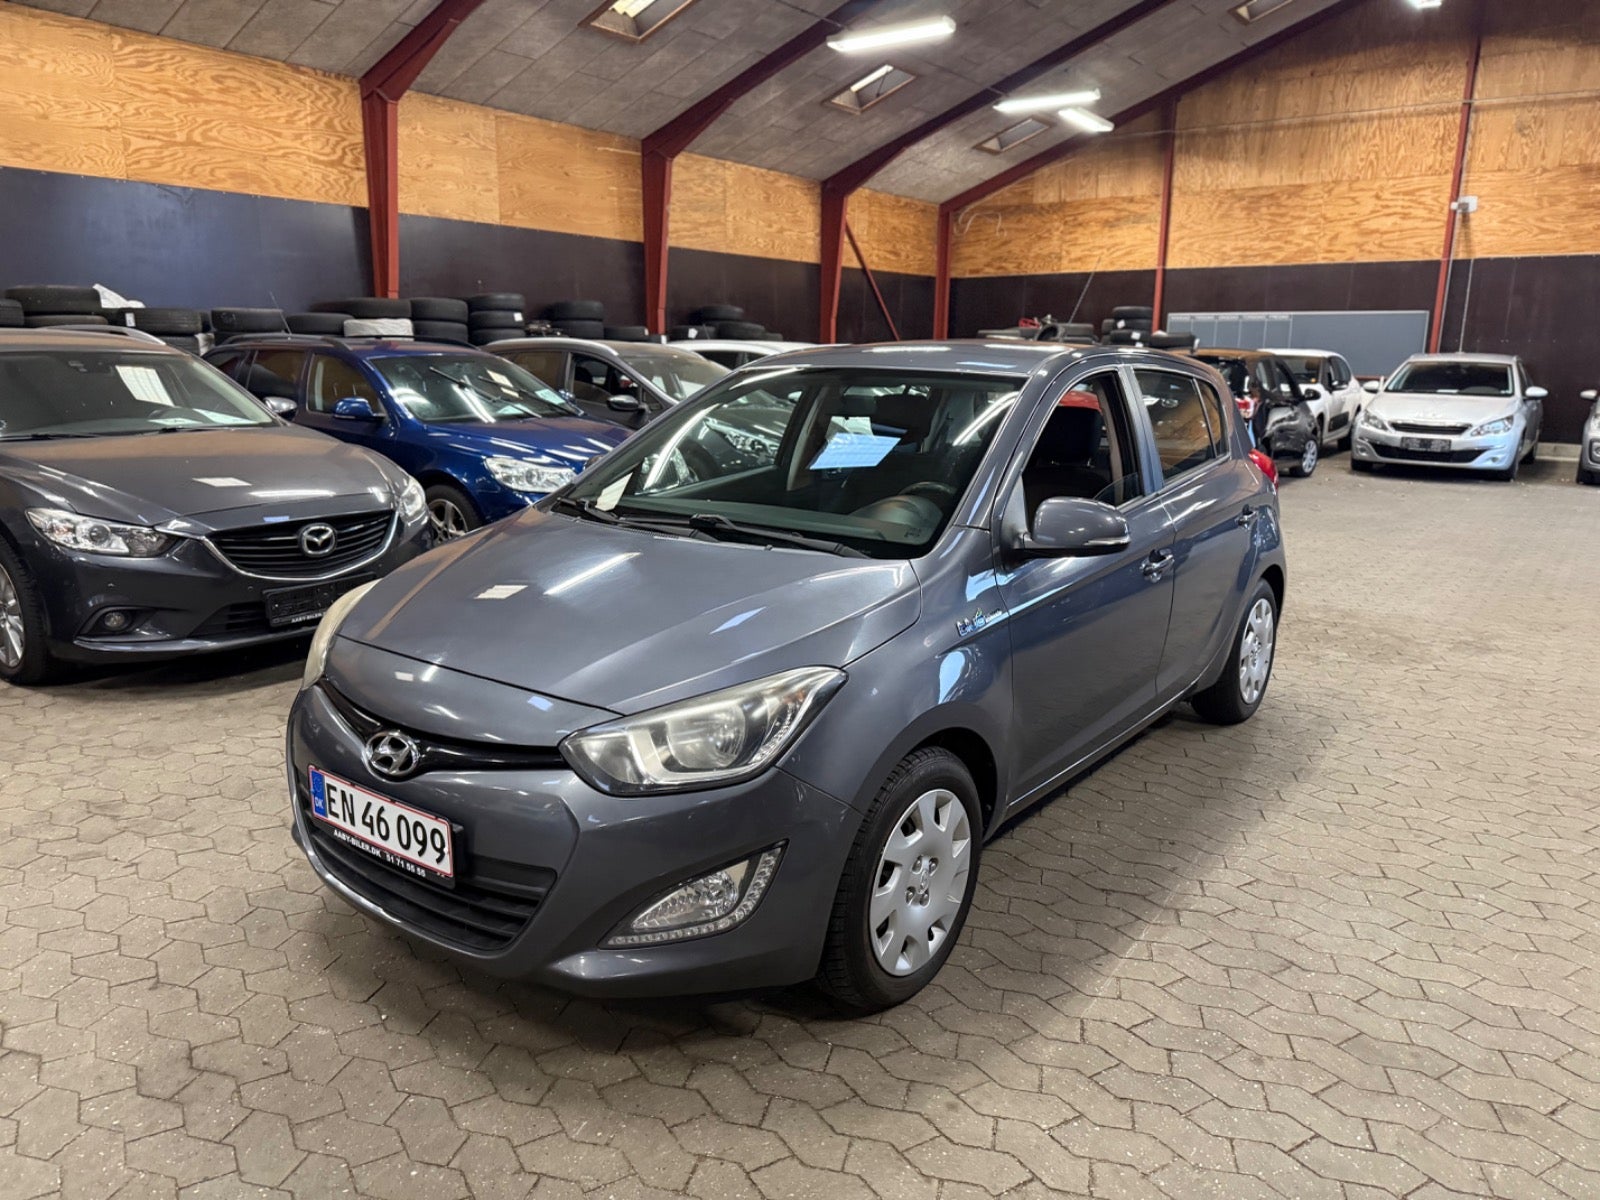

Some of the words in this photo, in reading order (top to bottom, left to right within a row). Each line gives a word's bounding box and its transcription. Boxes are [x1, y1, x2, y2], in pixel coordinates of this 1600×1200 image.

[314, 796, 324, 809] DK
[326, 782, 356, 827] EN
[361, 801, 390, 841] 46
[397, 814, 446, 864] 099
